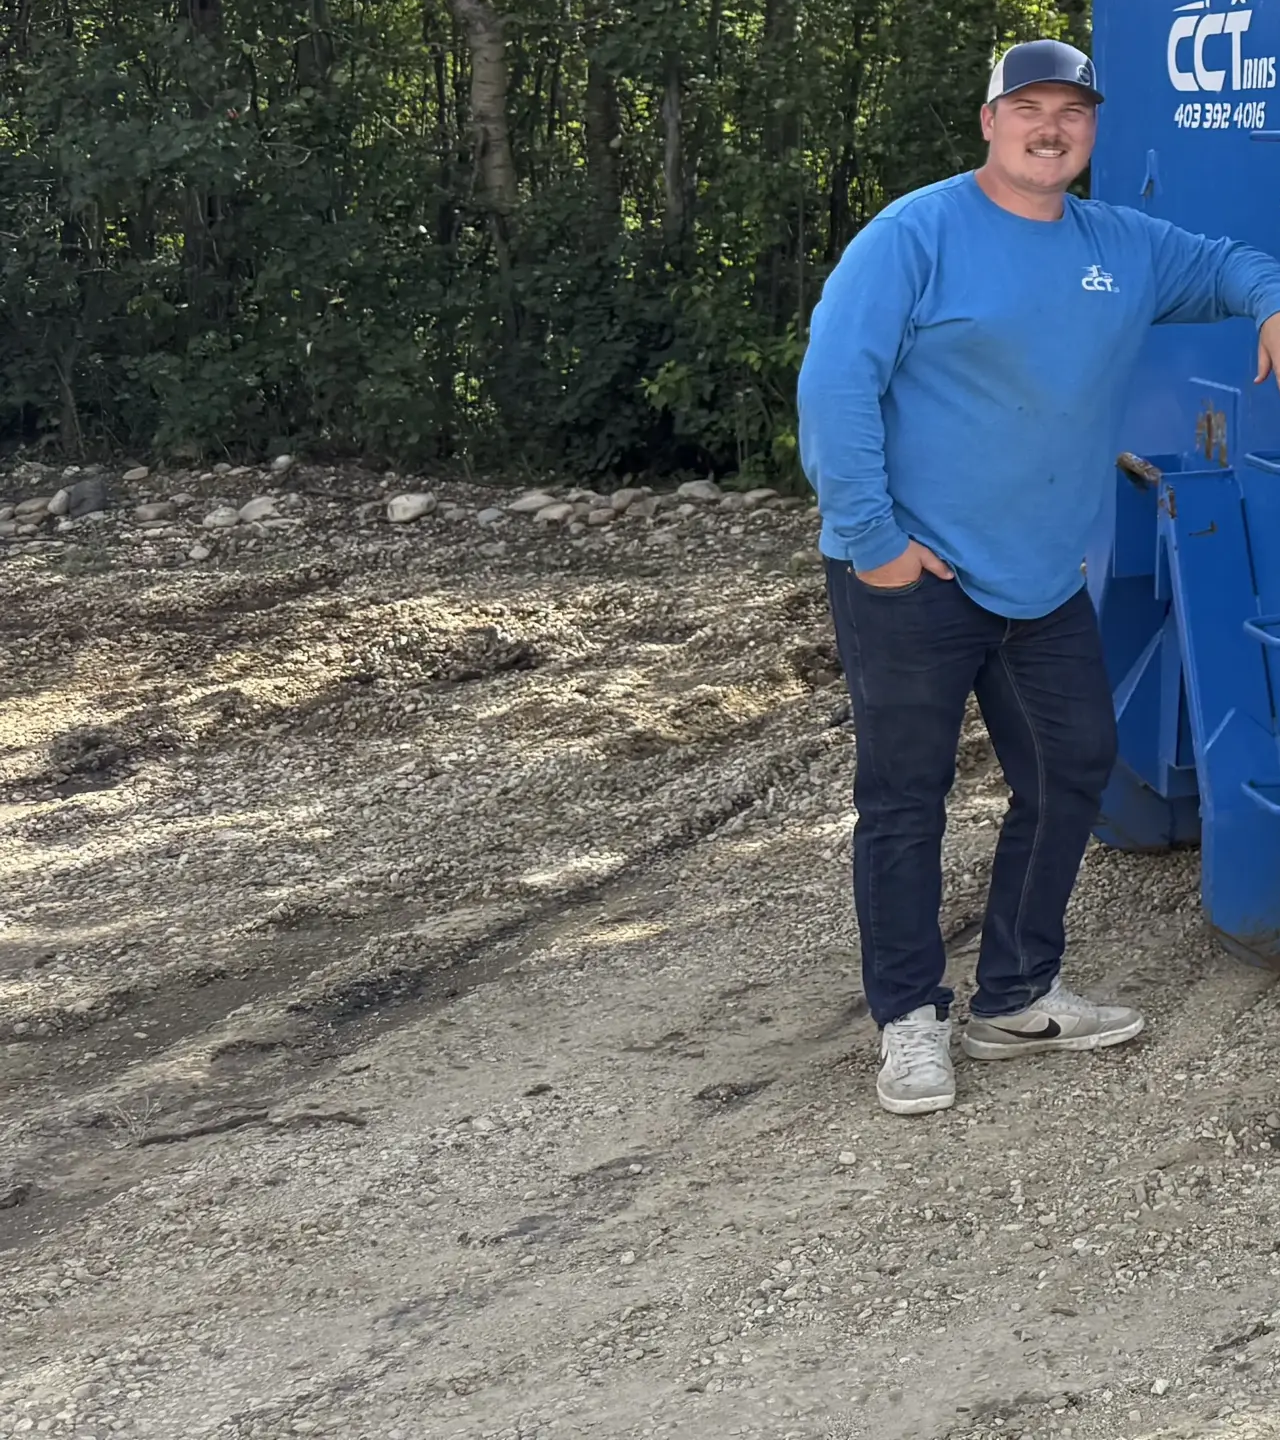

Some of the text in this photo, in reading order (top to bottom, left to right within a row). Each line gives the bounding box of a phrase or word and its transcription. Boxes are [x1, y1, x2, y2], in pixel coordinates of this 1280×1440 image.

[1167, 9, 1253, 92] CCT
[1174, 101, 1266, 129] 403 392 4016
[1081, 277, 1114, 292] CCT
